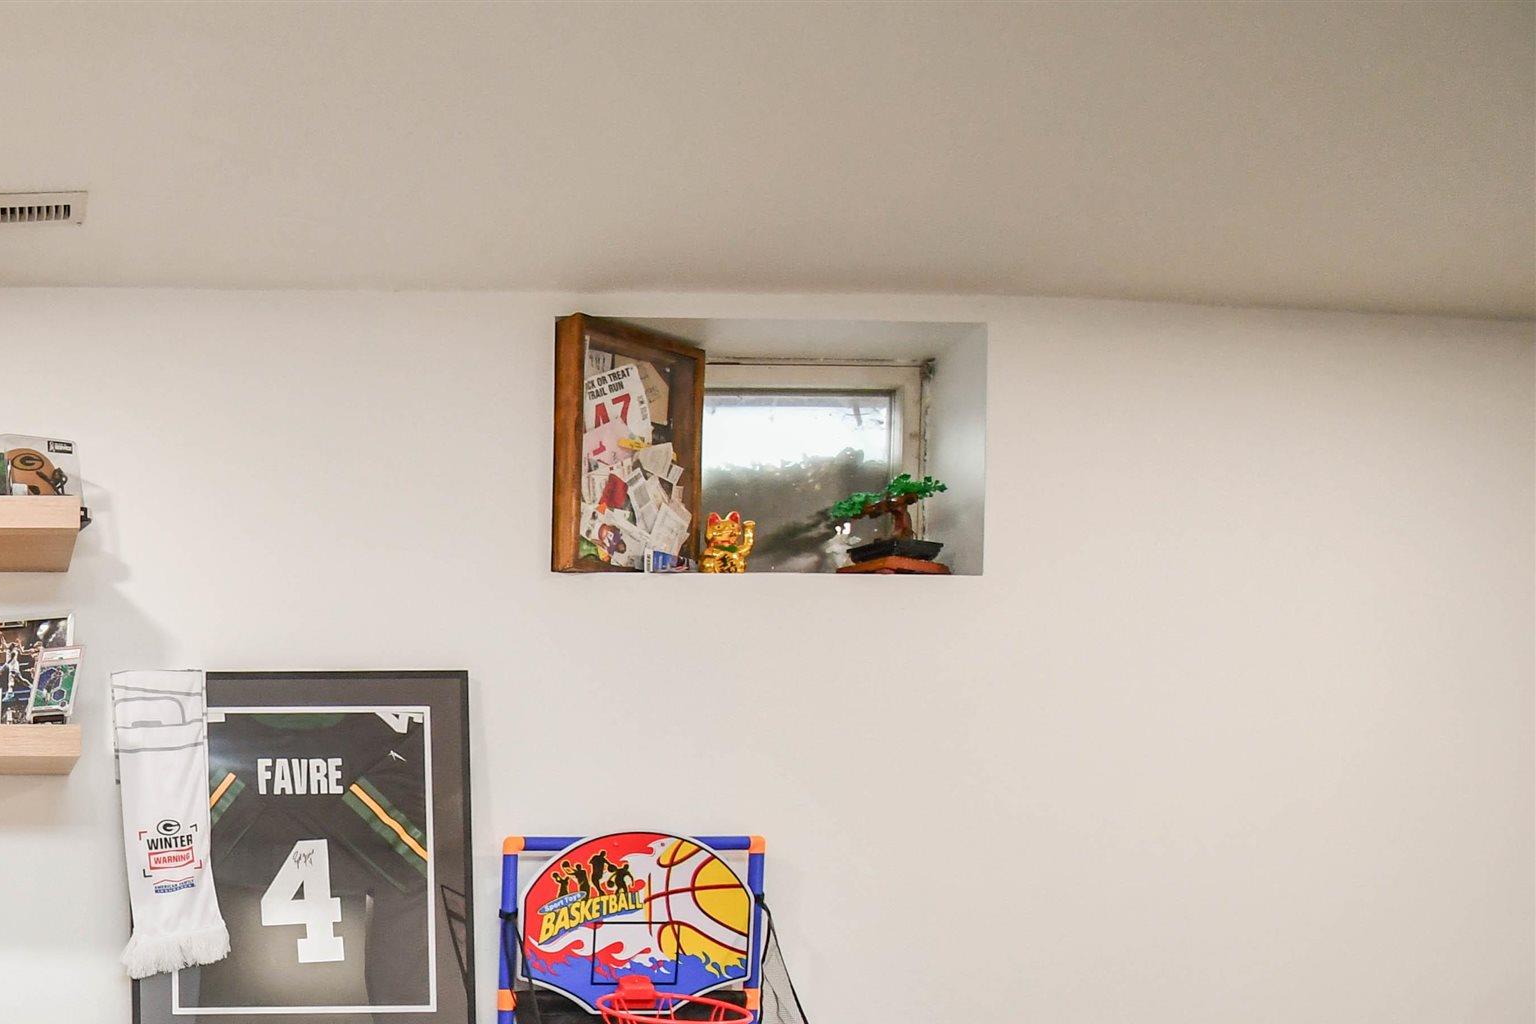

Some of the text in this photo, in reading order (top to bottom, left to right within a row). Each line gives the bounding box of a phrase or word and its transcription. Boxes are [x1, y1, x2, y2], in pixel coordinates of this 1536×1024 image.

[597, 376, 608, 385] OR
[588, 381, 624, 400] TRAIL RUN
[257, 757, 344, 796] FAVRE
[146, 834, 193, 850] WINTER
[153, 852, 191, 865] WARNING
[261, 839, 345, 963] 4
[538, 890, 644, 945] BASKETBALL
